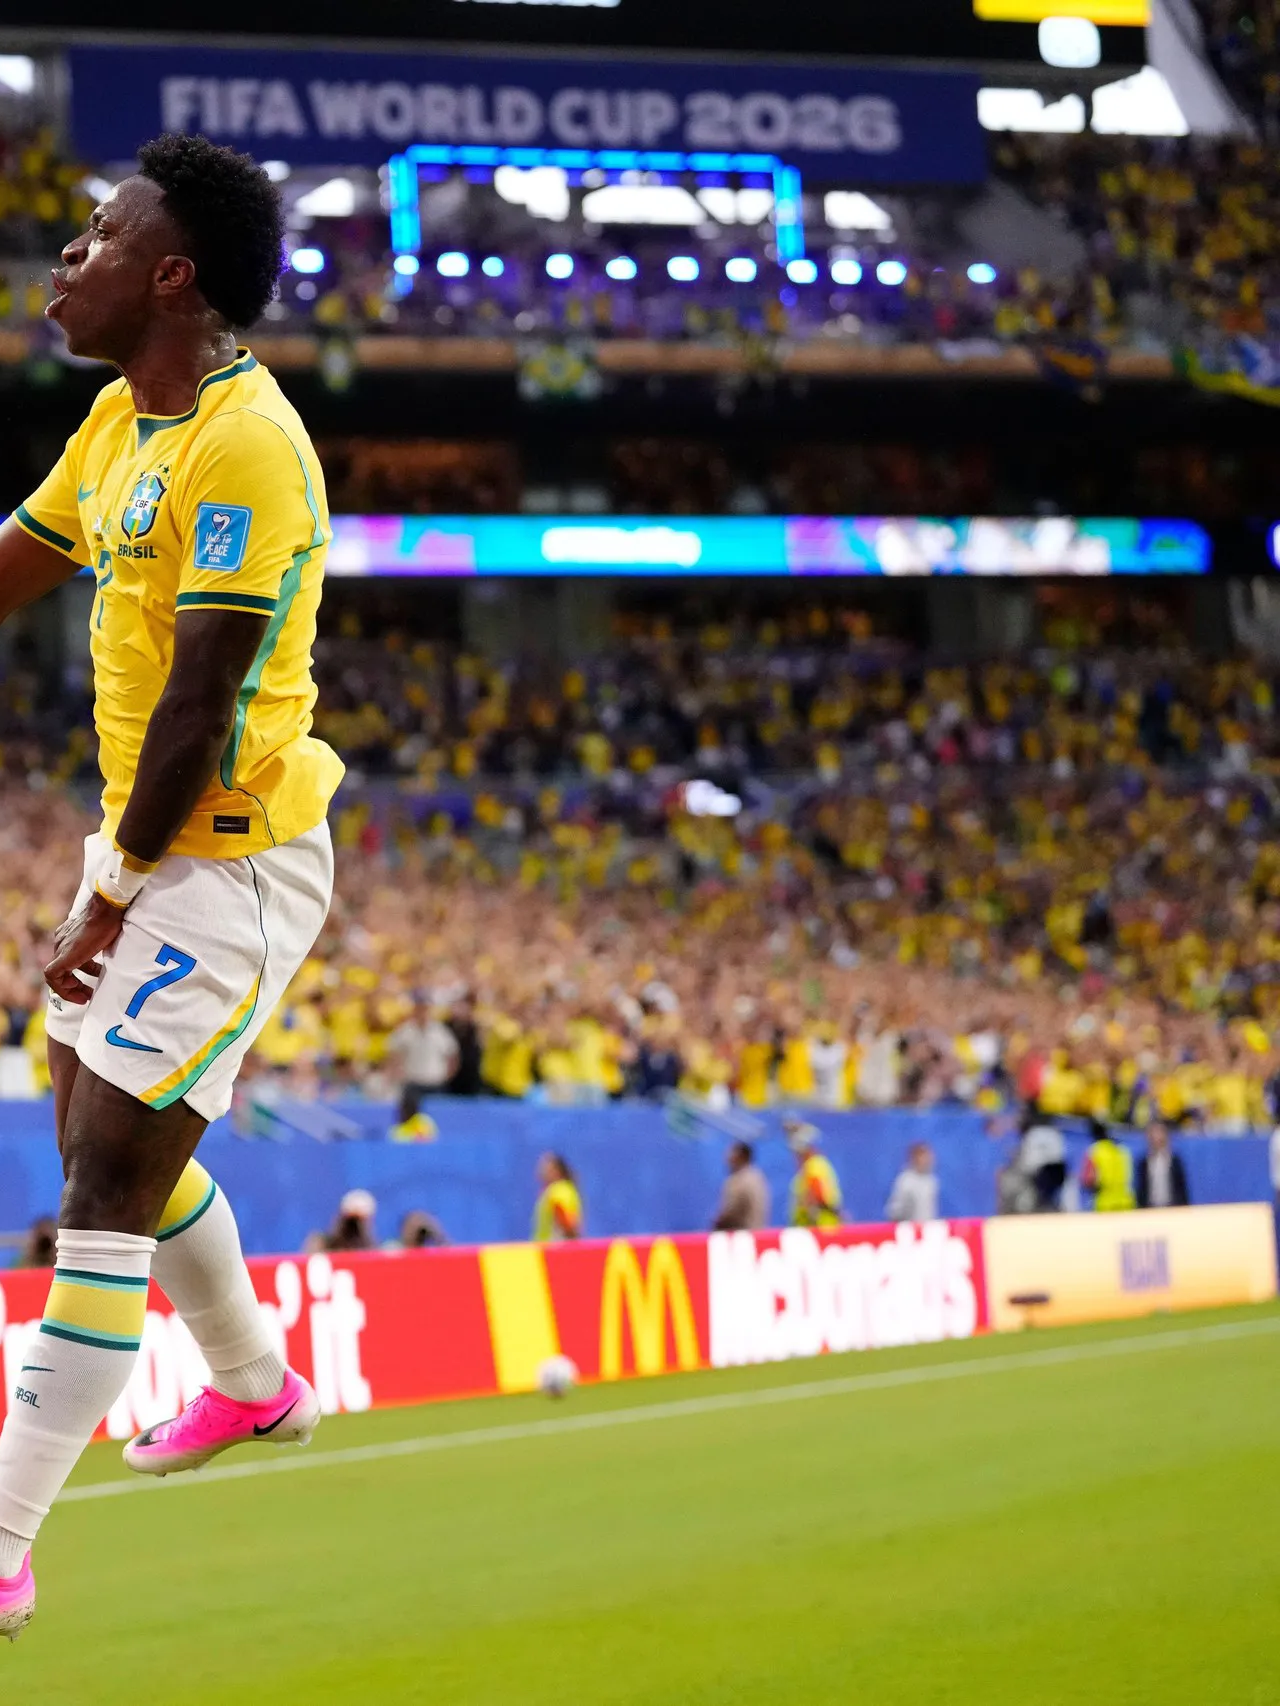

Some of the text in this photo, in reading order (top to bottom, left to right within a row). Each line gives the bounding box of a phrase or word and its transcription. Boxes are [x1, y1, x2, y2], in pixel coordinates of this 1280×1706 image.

[158, 77, 902, 152] FIFA WORLD CUP 2026
[134, 499, 150, 509] CBF
[222, 533, 233, 545] For
[117, 543, 158, 559] BRASIL
[203, 543, 229, 556] PEACE
[125, 943, 197, 1019] 7
